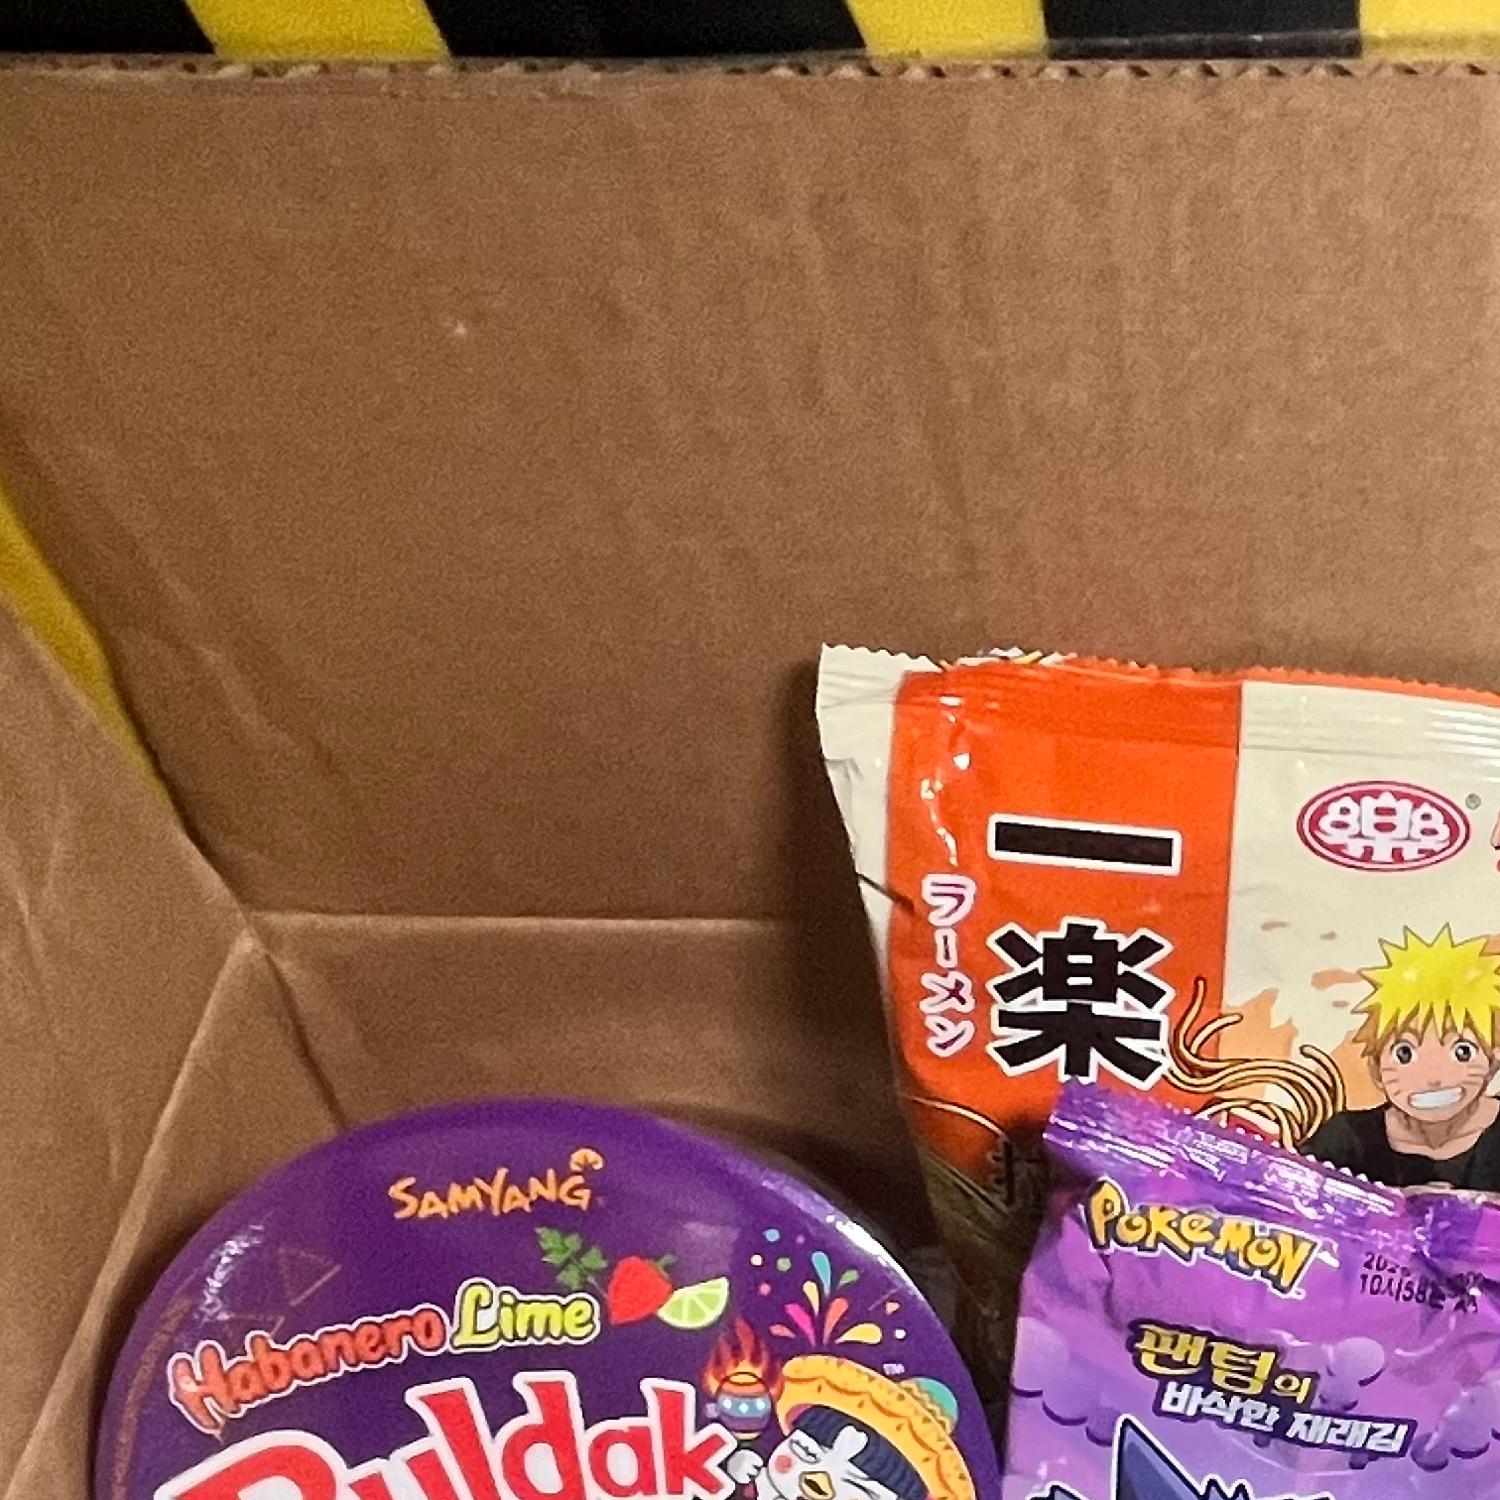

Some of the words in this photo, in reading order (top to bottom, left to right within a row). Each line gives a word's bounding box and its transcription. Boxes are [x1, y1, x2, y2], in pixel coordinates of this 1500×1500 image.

[921, 874, 978, 1058] ラーメン
[169, 1304, 450, 1441] Habanero
[452, 1278, 600, 1354] Lime
[1134, 1324, 1314, 1404] 팬텀의
[1292, 1409, 1411, 1456] 재래김
